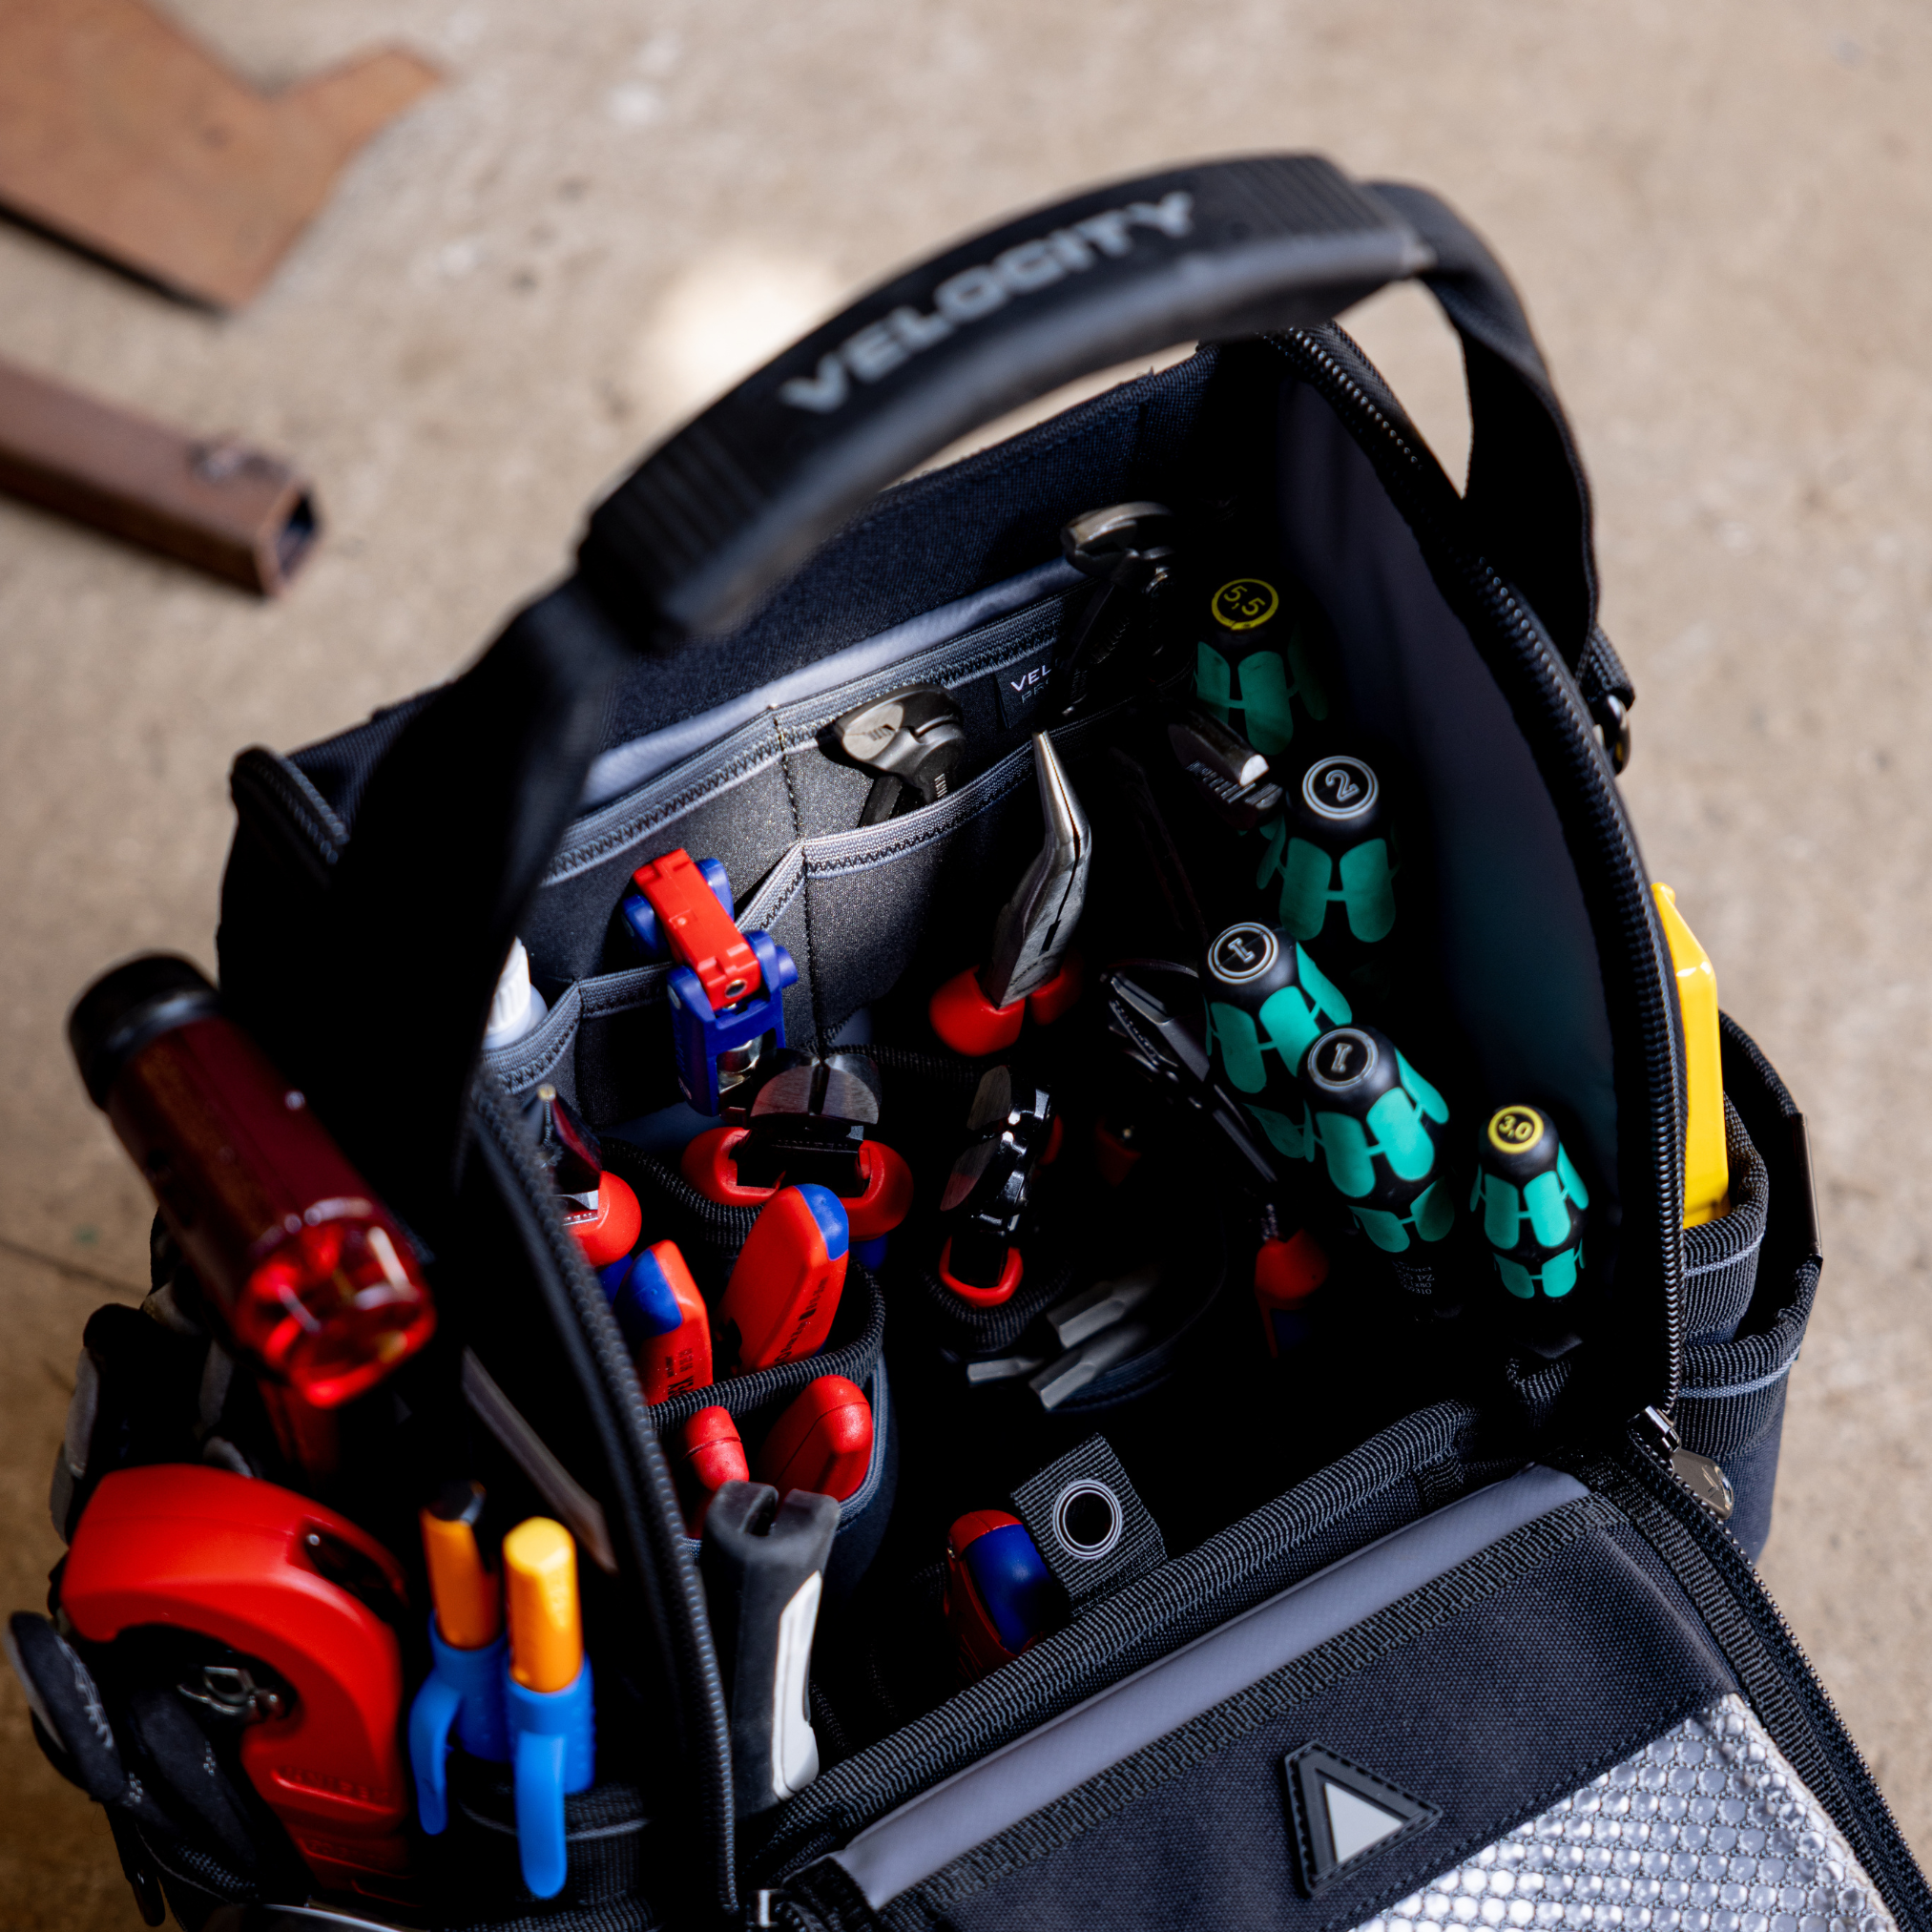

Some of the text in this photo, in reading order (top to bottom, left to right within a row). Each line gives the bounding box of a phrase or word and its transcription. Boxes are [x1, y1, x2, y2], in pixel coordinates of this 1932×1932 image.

[779, 191, 1195, 415] VELOCITY
[1324, 769, 1360, 801] 2
[1228, 937, 1256, 963] 1
[1330, 1042, 1353, 1073] 1
